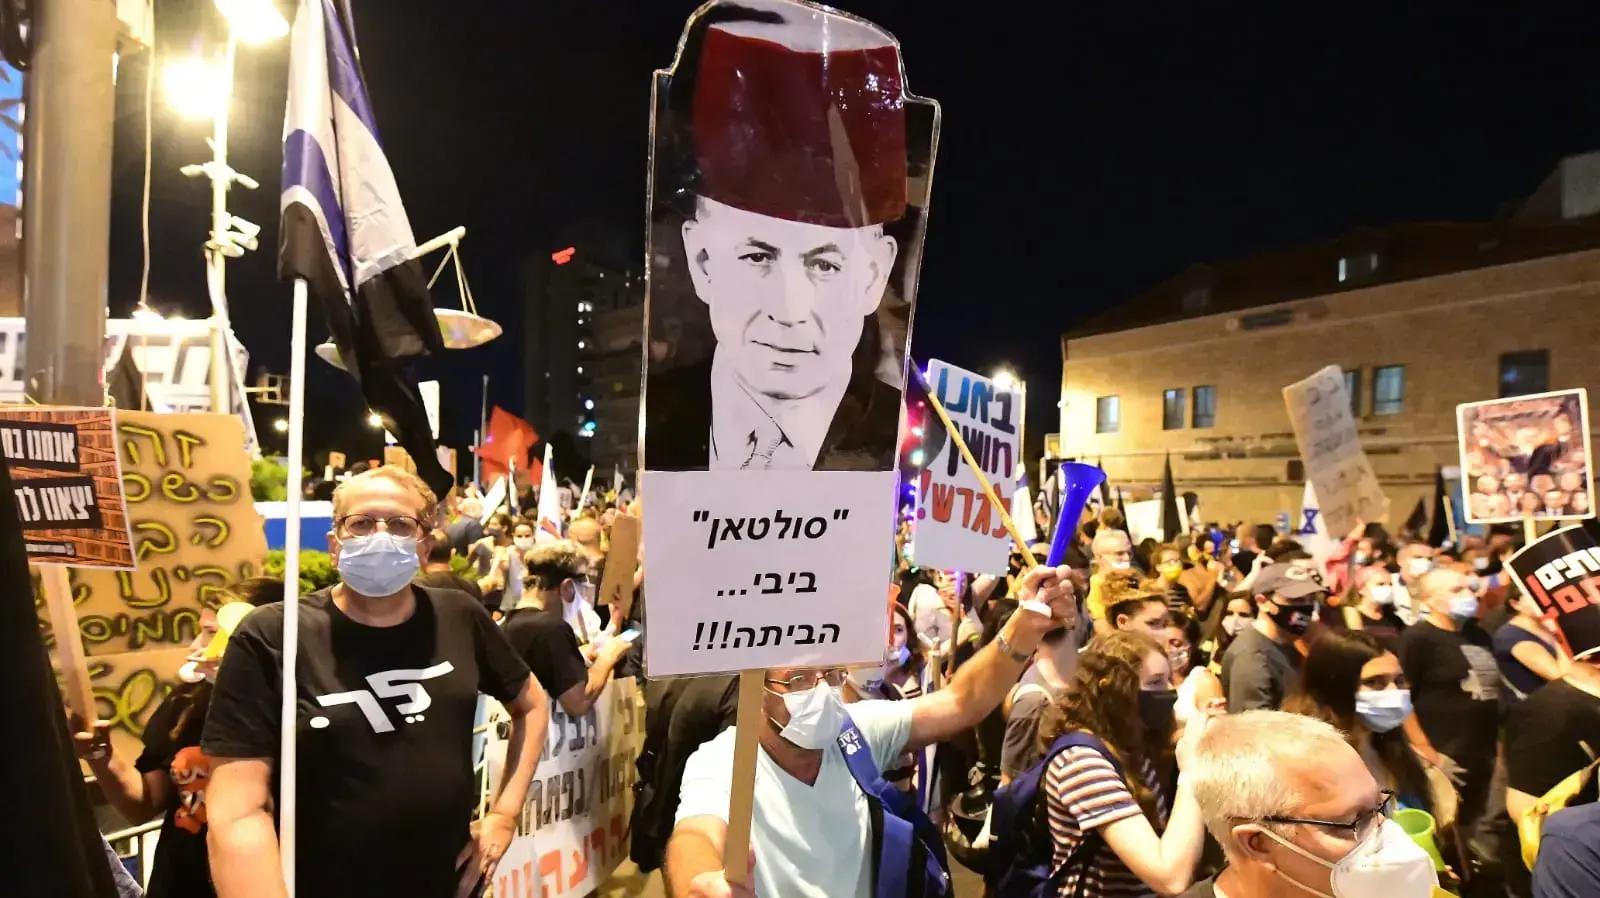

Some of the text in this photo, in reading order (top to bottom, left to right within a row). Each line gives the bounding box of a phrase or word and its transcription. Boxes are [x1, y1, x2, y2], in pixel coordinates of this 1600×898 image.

[937, 367, 1015, 435] באנו
[26, 429, 77, 464] אנחנו
[40, 486, 95, 521] יצאנו
[917, 469, 1012, 539] לגרש!
[692, 509, 849, 549] "סולטאן"
[717, 571, 817, 597] ביבי...
[692, 620, 841, 651] הביתה!!!
